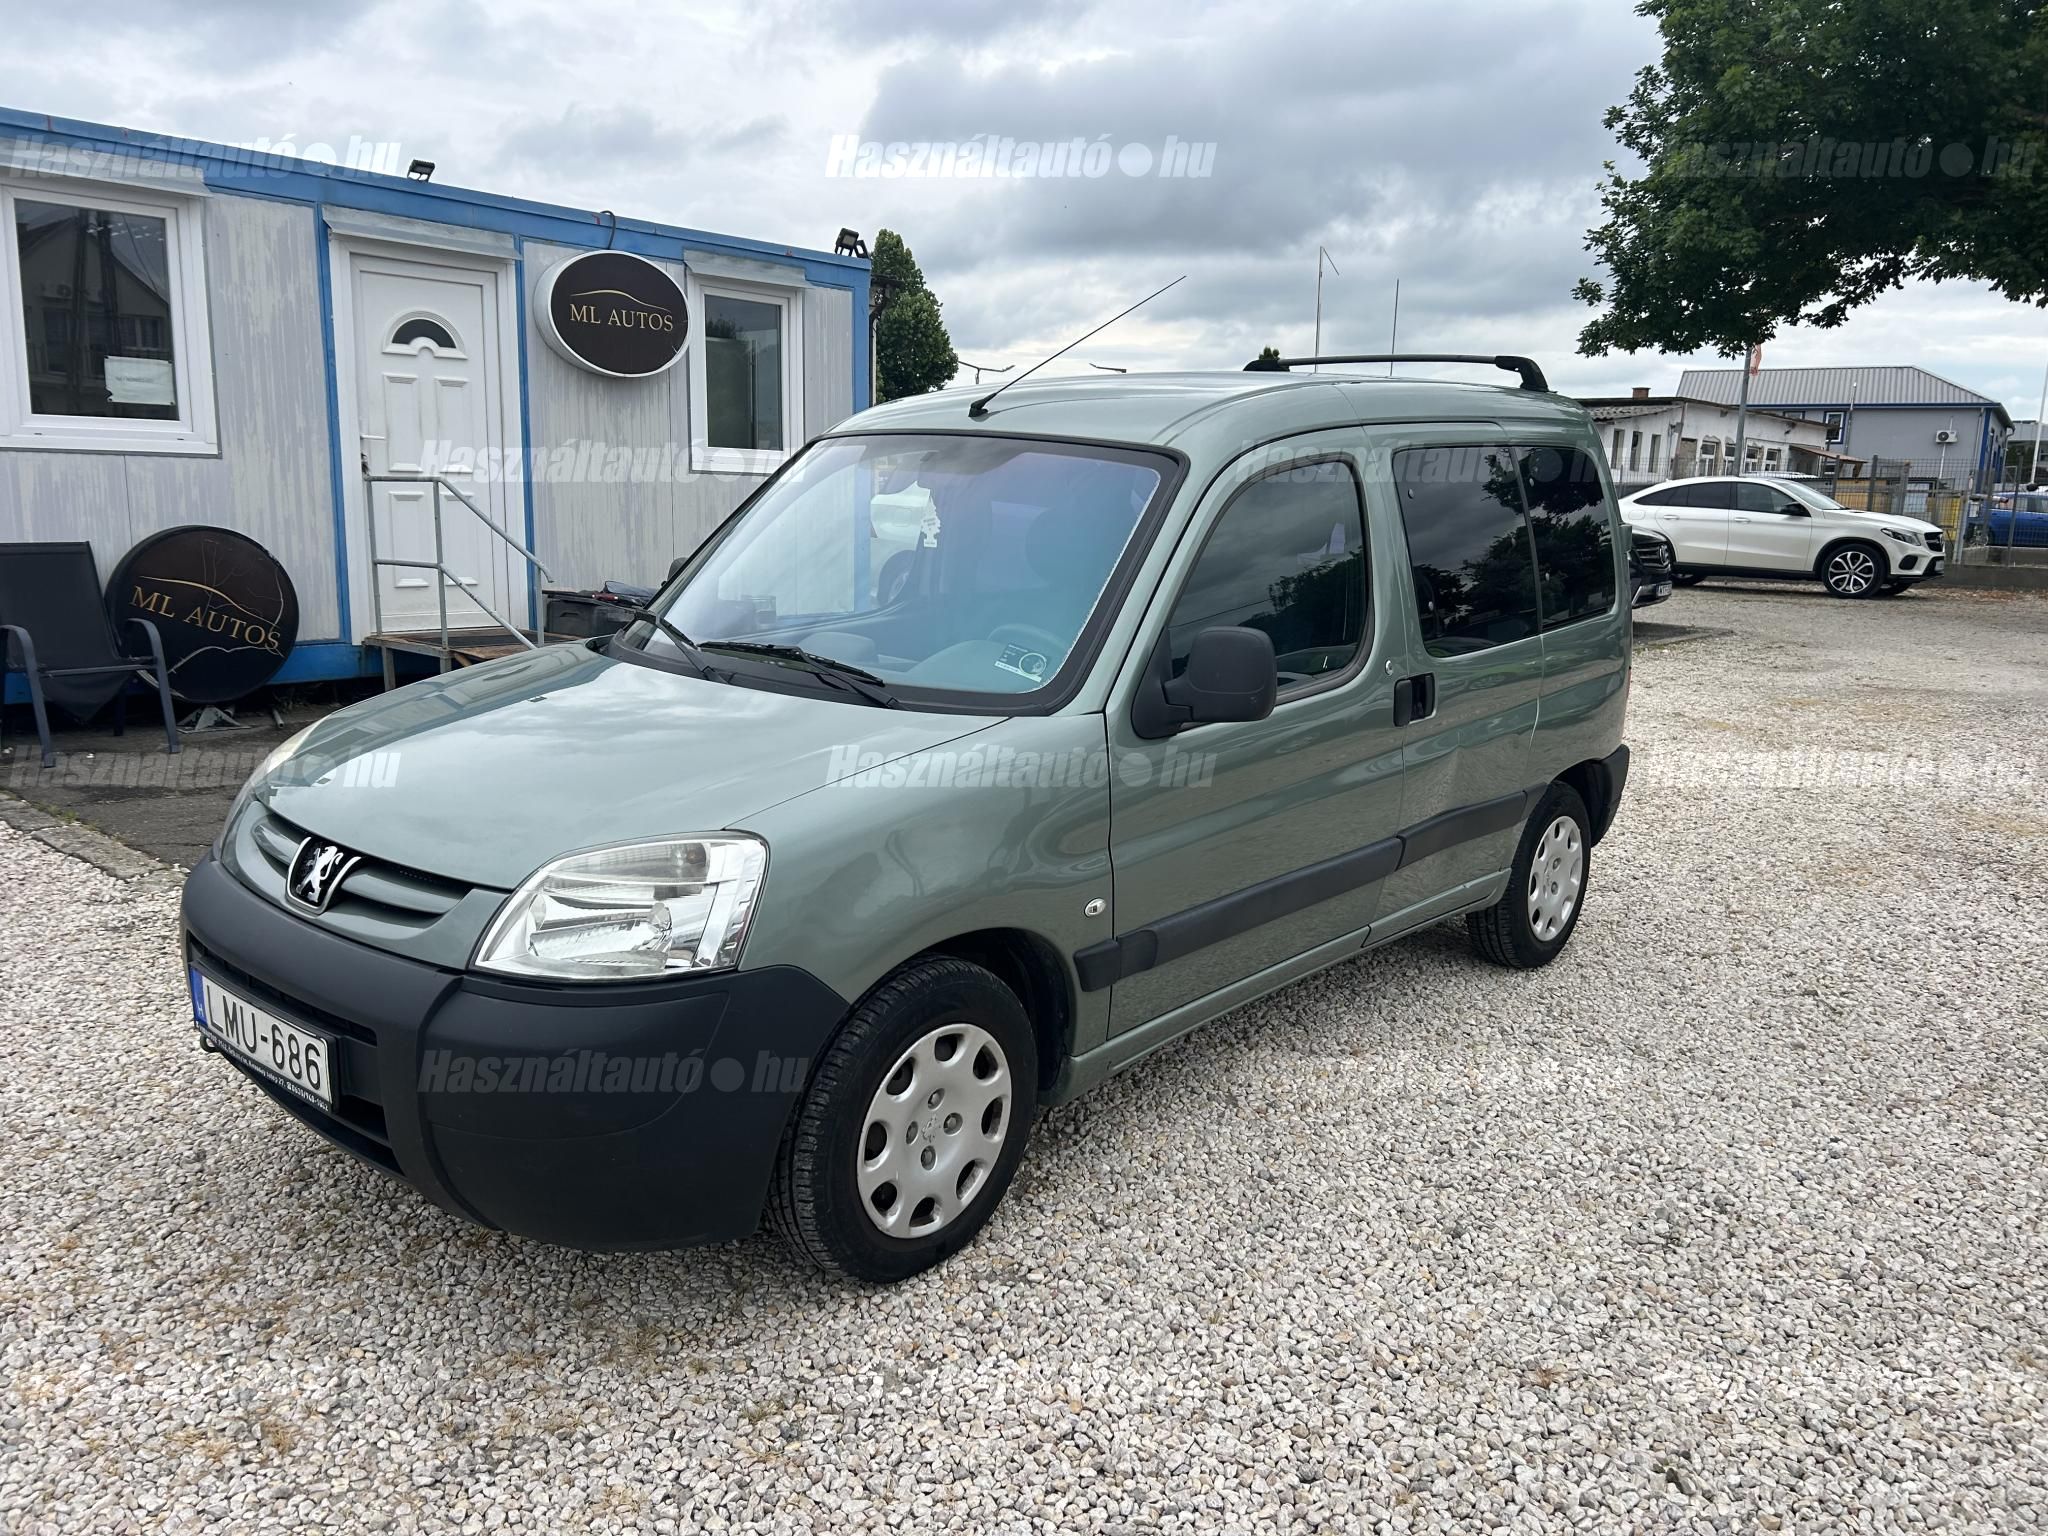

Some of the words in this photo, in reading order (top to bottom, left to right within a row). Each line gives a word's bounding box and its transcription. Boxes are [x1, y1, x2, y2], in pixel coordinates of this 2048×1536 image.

[570, 303, 601, 324] ML
[607, 308, 673, 332] AUTOS
[130, 585, 175, 618] ML
[183, 606, 281, 651] AUTOS
[206, 984, 321, 1091] LMU-686
